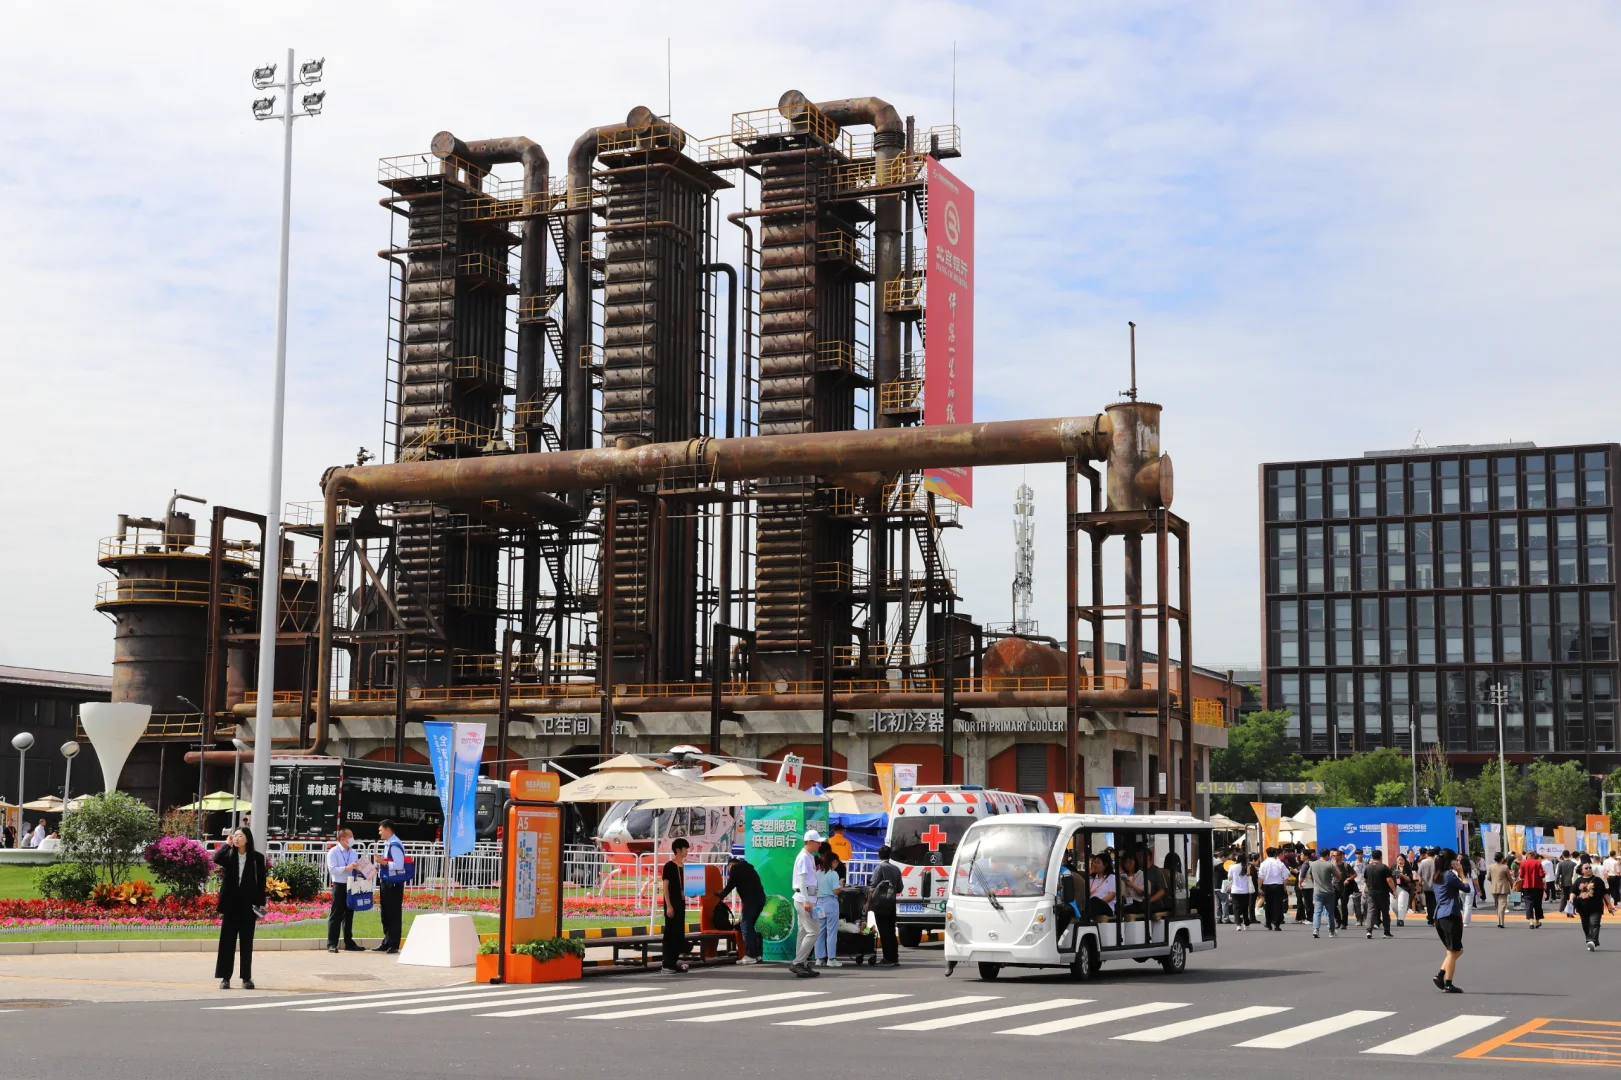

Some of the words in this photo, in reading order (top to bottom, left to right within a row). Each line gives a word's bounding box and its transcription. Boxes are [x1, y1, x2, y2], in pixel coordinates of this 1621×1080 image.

[538, 716, 590, 735] 卫生间
[868, 711, 944, 732] 北初冷器
[958, 721, 987, 732] NORTH
[989, 721, 1027, 732] PRIMARY
[1030, 720, 1064, 732] COOLER
[307, 784, 337, 796] 请勿靠近
[361, 777, 404, 794] 武装押运
[1209, 782, 1236, 793] 11-14
[1288, 783, 1307, 793] 1-3
[346, 811, 364, 820] E1552
[517, 817, 529, 829] A5
[752, 820, 797, 832] 零塑服贸
[752, 835, 797, 848] 低碳同行
